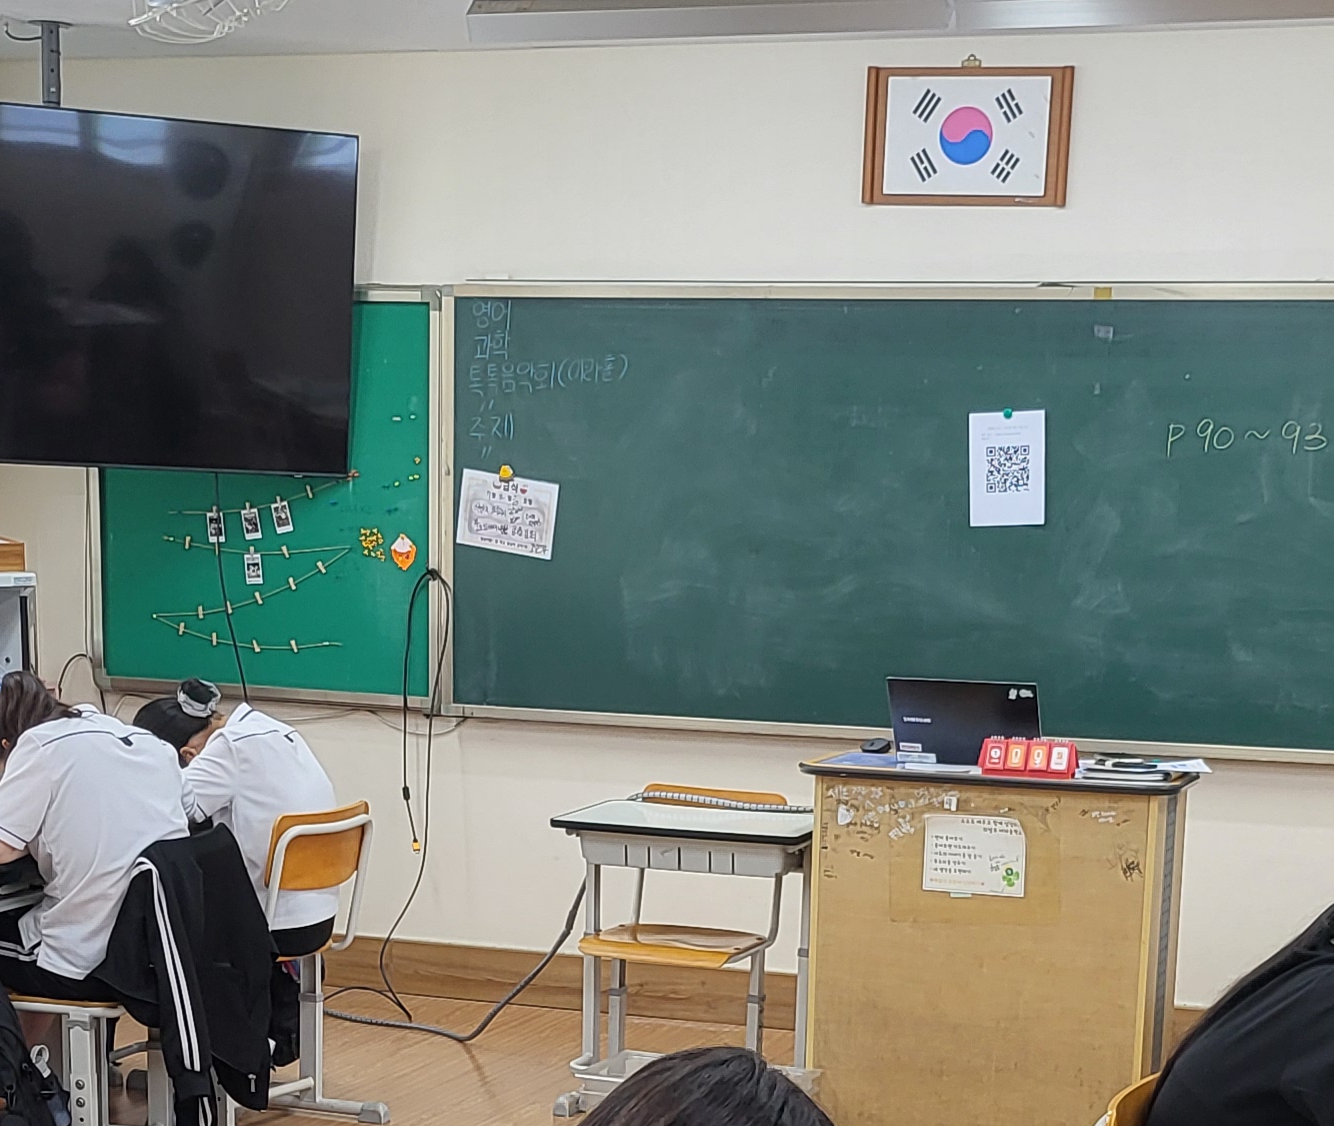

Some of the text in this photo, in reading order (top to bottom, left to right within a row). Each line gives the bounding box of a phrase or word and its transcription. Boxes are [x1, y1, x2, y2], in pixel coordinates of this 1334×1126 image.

[473, 300, 511, 330] 영어
[475, 330, 511, 360] 과학
[470, 413, 514, 441] 주제
